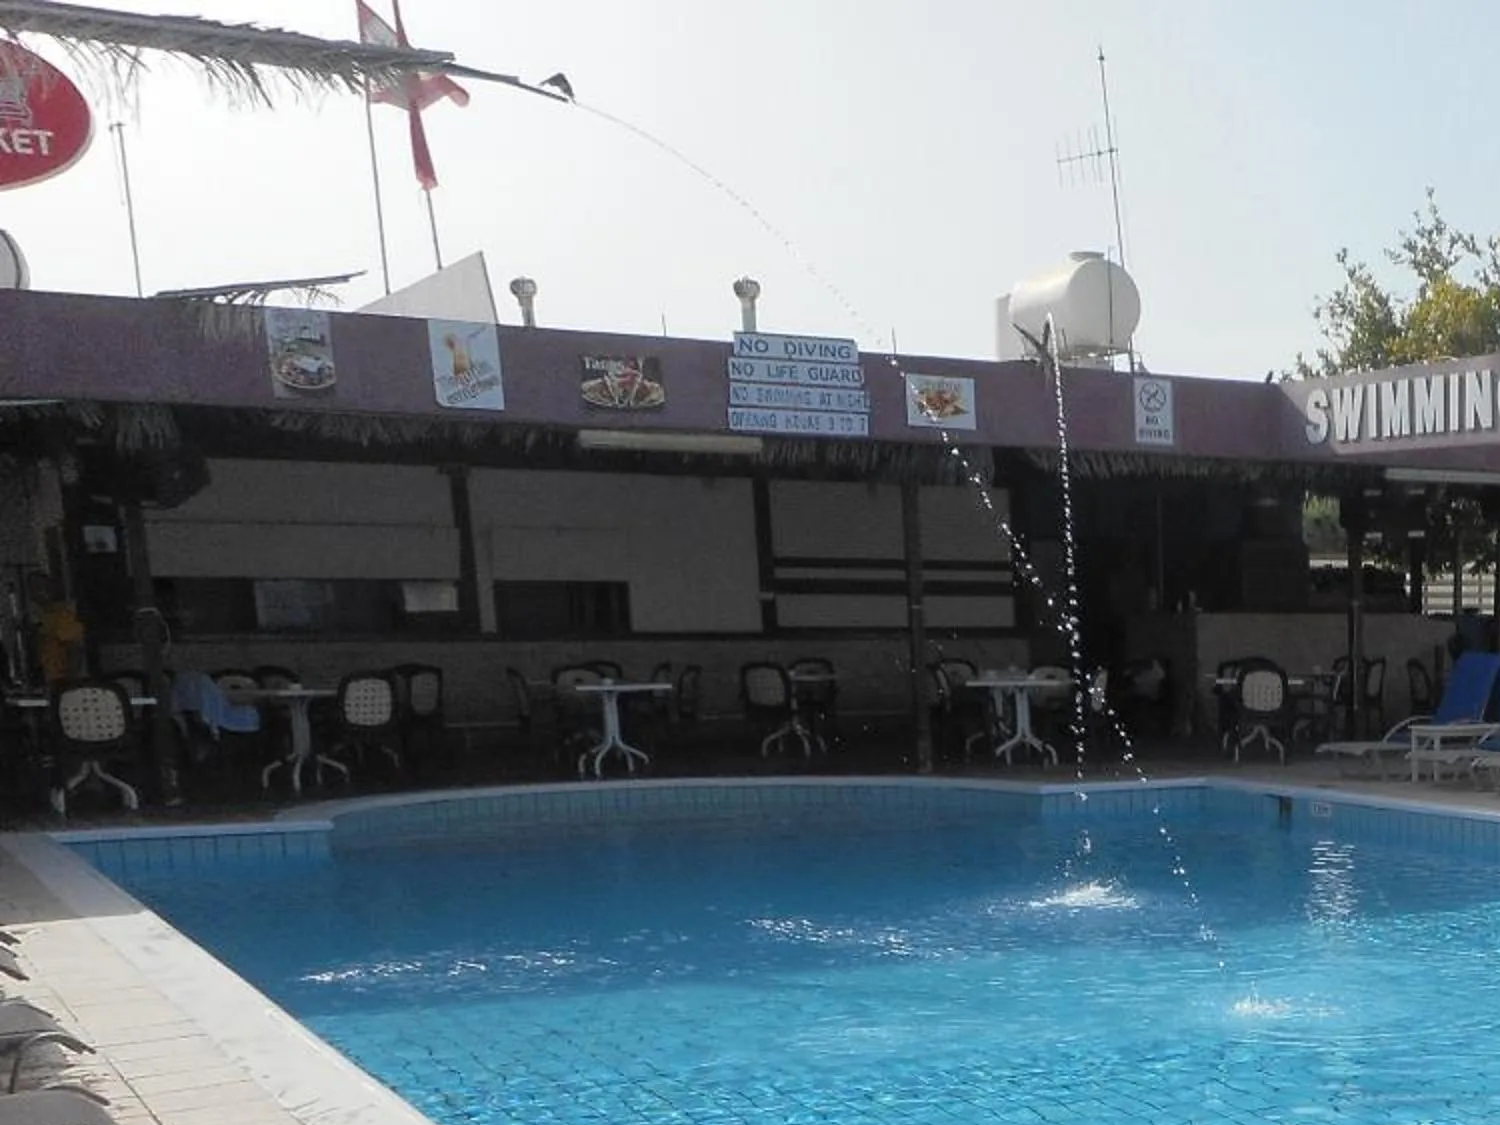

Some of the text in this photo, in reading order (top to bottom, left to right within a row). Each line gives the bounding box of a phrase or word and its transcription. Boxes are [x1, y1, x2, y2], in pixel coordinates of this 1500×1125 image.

[740, 339, 851, 358] NO DIVING
[731, 361, 863, 382] NO LIFE GUARD
